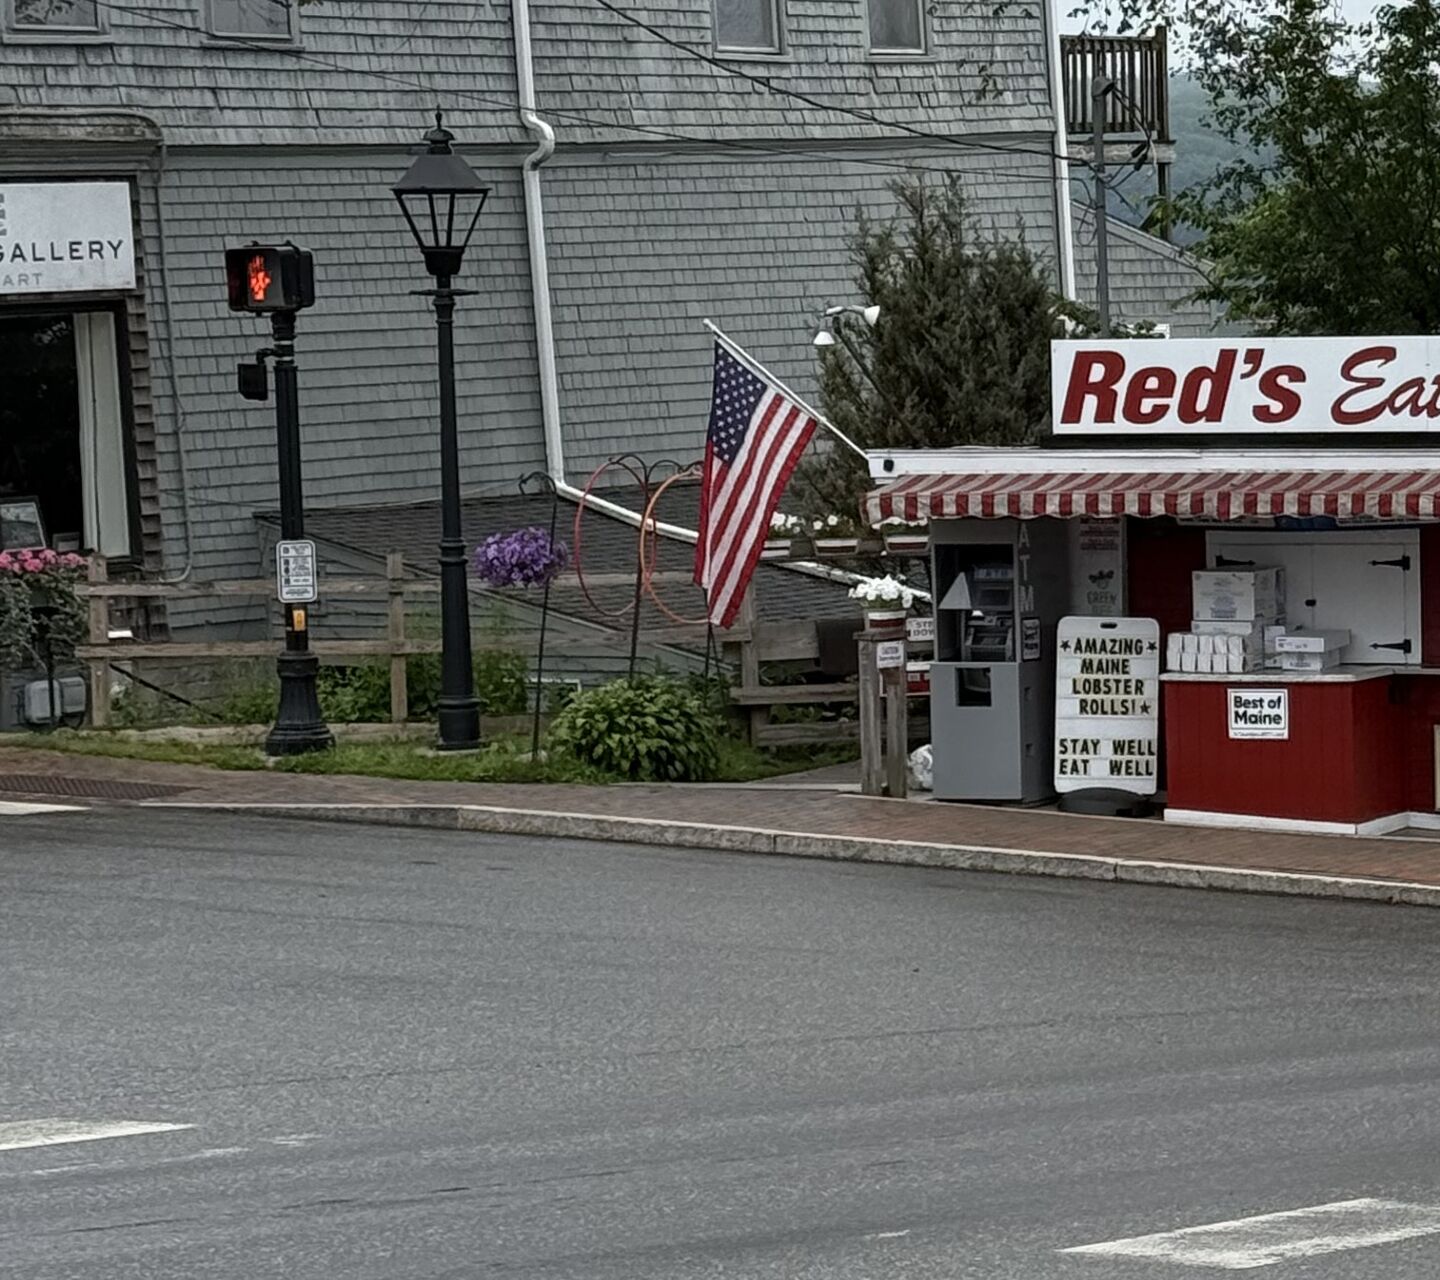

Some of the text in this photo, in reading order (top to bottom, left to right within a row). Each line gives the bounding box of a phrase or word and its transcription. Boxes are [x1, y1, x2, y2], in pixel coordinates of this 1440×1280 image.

[1060, 348, 1307, 424] Red's
[1073, 637, 1143, 655] AMAZING
[1080, 658, 1131, 675] MAINE
[1072, 678, 1144, 696] LOBSTER
[1079, 699, 1136, 716] ROLLS!
[1233, 695, 1282, 709] Best of
[1233, 710, 1283, 725] Maine
[1059, 738, 1156, 756] STAY WELL
[1059, 759, 1154, 776] EAT WELL
